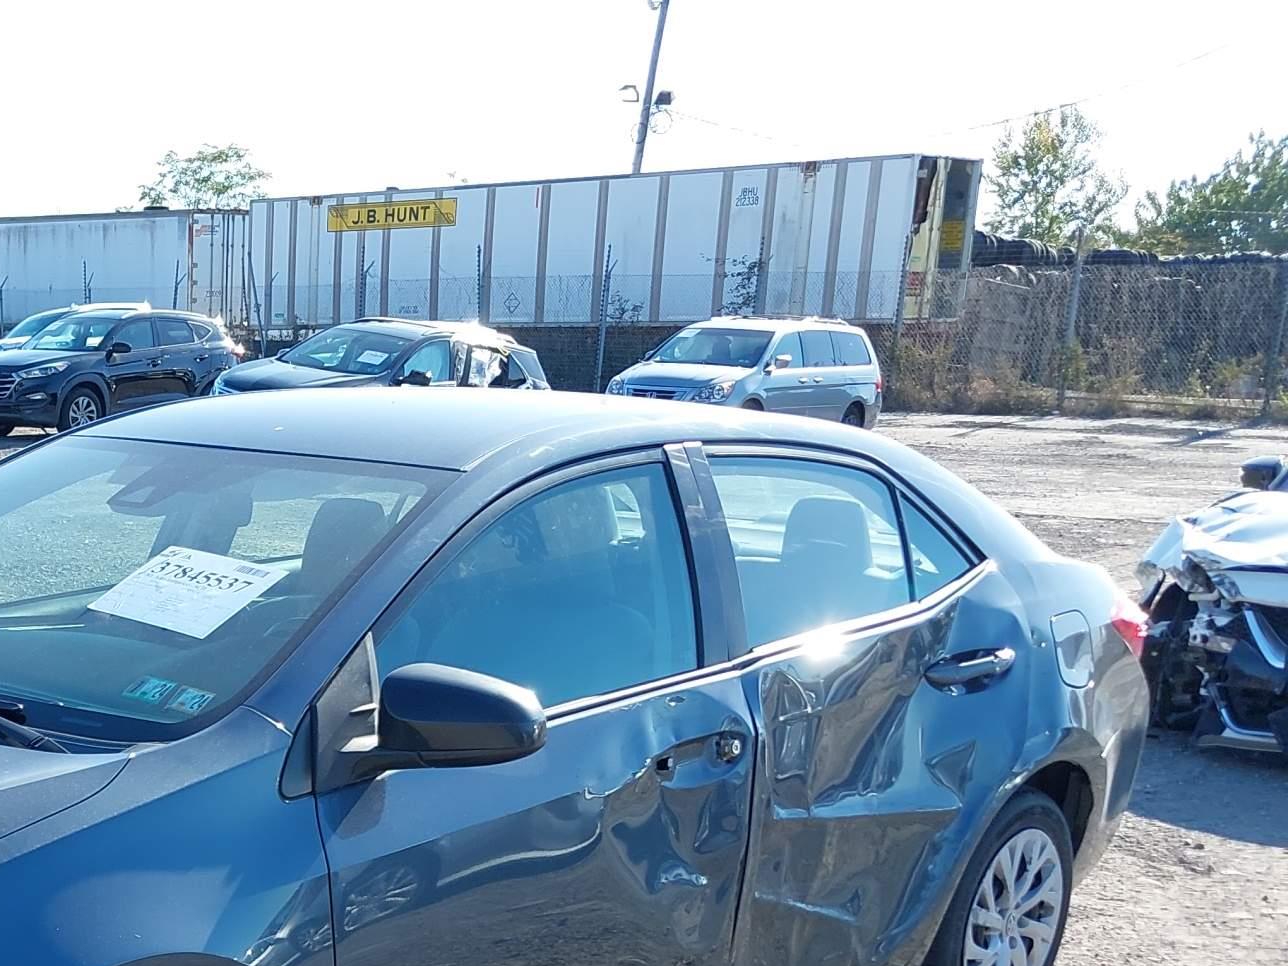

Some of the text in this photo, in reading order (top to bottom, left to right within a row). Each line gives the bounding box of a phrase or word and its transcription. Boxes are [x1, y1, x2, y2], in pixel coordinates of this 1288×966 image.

[739, 187, 758, 197] JBHU
[351, 206, 430, 225] J.B. HUNT
[150, 561, 254, 593] 37845537
